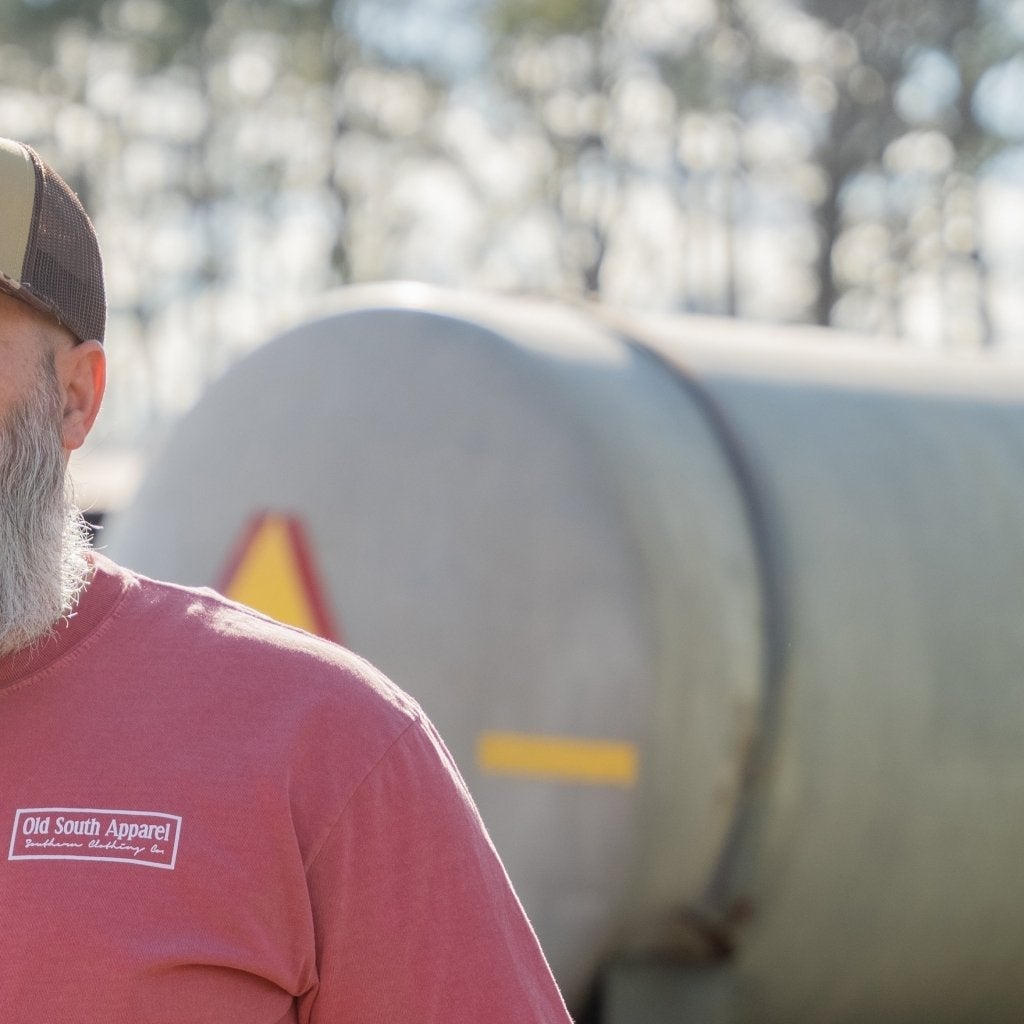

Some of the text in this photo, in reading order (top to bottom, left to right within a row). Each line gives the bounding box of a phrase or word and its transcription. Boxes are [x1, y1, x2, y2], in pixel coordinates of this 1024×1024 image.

[22, 816, 171, 841] Old South Apparel
[25, 838, 83, 848] Southern
[88, 840, 145, 856] Clothing
